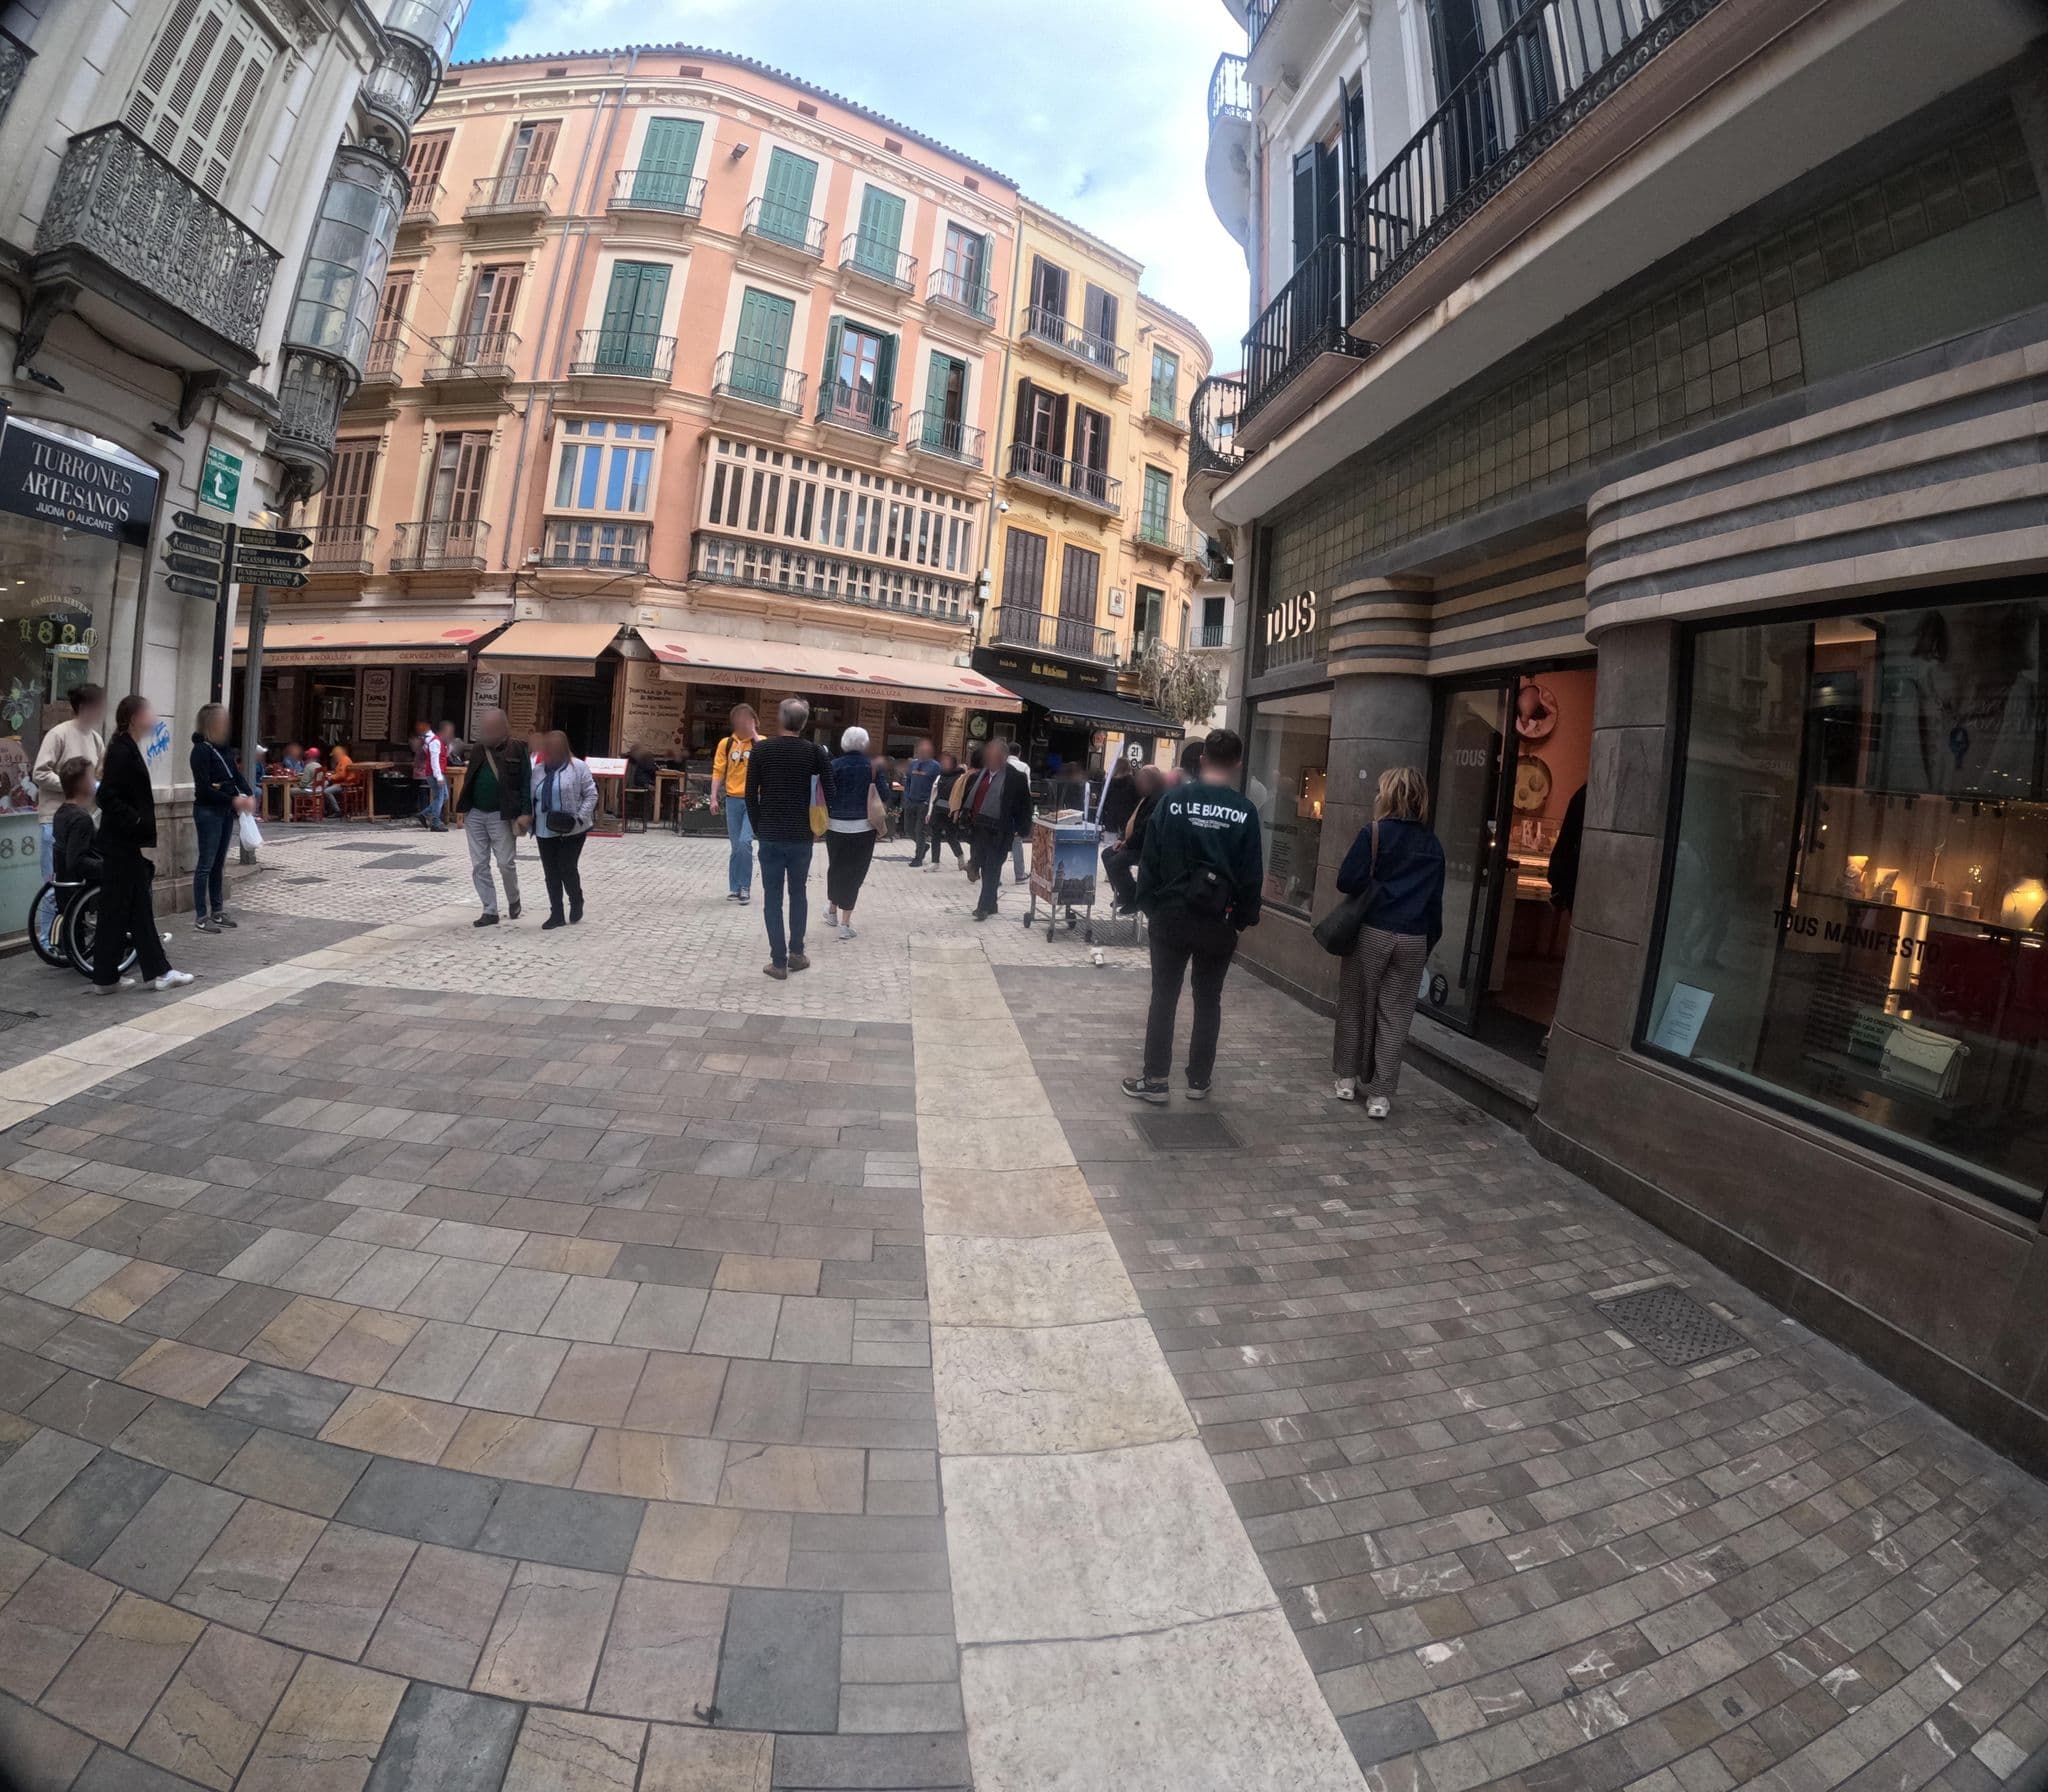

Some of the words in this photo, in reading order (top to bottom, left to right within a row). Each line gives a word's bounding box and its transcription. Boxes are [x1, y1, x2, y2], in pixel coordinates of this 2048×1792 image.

[32, 442, 133, 496] TURRONES
[21, 471, 130, 522] ARTESANOS
[75, 513, 114, 532] ALICANTE
[1262, 590, 1316, 645] TOUS
[19, 618, 98, 648] 1880
[271, 654, 305, 662] TABERNA
[475, 692, 498, 701] TAPAS
[818, 683, 856, 692] TABERNA
[860, 687, 902, 697] ANDALUZA
[1456, 749, 1487, 767] TOUS
[1202, 804, 1248, 824] BUXTON
[1773, 910, 1819, 936] TOUS
[1824, 920, 1940, 964] MANIFESTO
